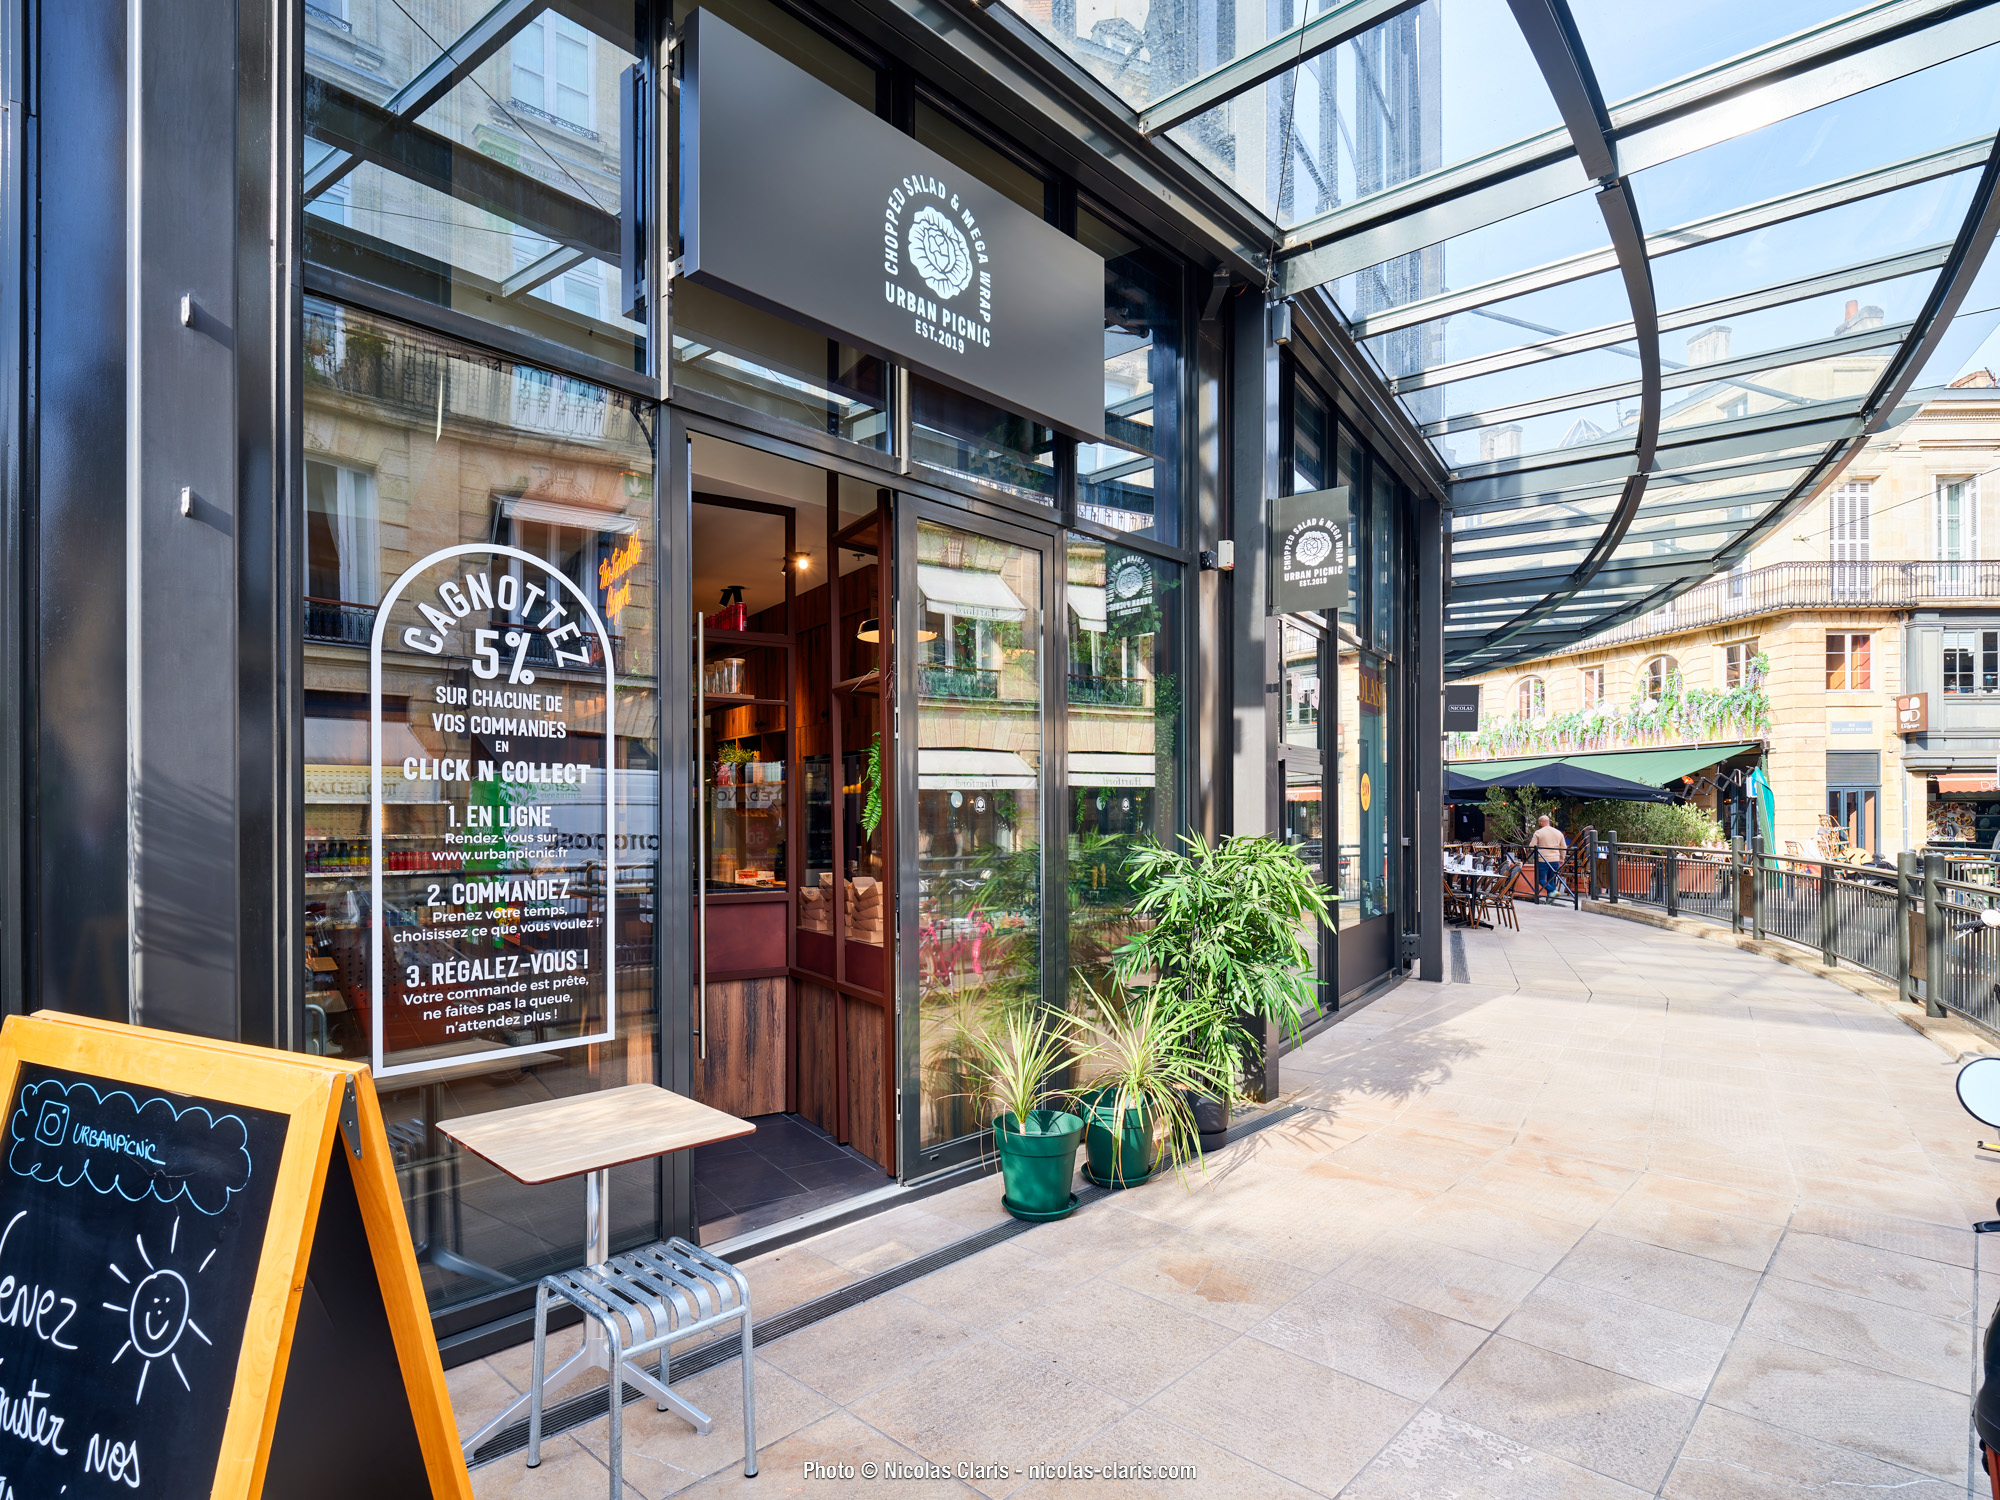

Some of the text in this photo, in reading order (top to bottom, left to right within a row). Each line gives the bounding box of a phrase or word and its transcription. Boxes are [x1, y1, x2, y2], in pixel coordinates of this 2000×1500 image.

[884, 175, 991, 323] CHOPPED SALAD & MEGA WRAP
[885, 281, 990, 347] URBAN PICNIC
[915, 319, 965, 354] EST.2019
[1284, 534, 1295, 570] CHOPPED
[1293, 518, 1316, 534] SALAD
[1319, 518, 1324, 526] &
[1325, 520, 1342, 540] MEGA
[1284, 565, 1343, 581] URBAN PICNIC
[1299, 577, 1327, 587] EST.2019
[404, 572, 590, 668] CAGNOTTEZ
[472, 628, 535, 685] 5%
[435, 685, 563, 713] SUR CHACUNE DE
[432, 712, 567, 739] VOS COMMANDES
[495, 740, 509, 753] EN
[403, 757, 590, 784] CLICK N COLLECT
[449, 805, 551, 827] 1. EN LIGNE
[445, 833, 557, 845] Rendez-vous sur
[432, 848, 568, 862] www.urbanpicnic.fr
[427, 879, 571, 907] 2. COMMANDEZ
[433, 904, 568, 923] Prenez votre temps,
[393, 917, 599, 943] choisissez ce que vous voulez !
[406, 949, 588, 989] 3. RÉGALEZ-VOUS !
[403, 975, 589, 1006] Votre commande est prête,
[423, 993, 573, 1021] ne faites pas la queue,
[524, 1009, 551, 1026] plus
[554, 1008, 558, 1020] !
